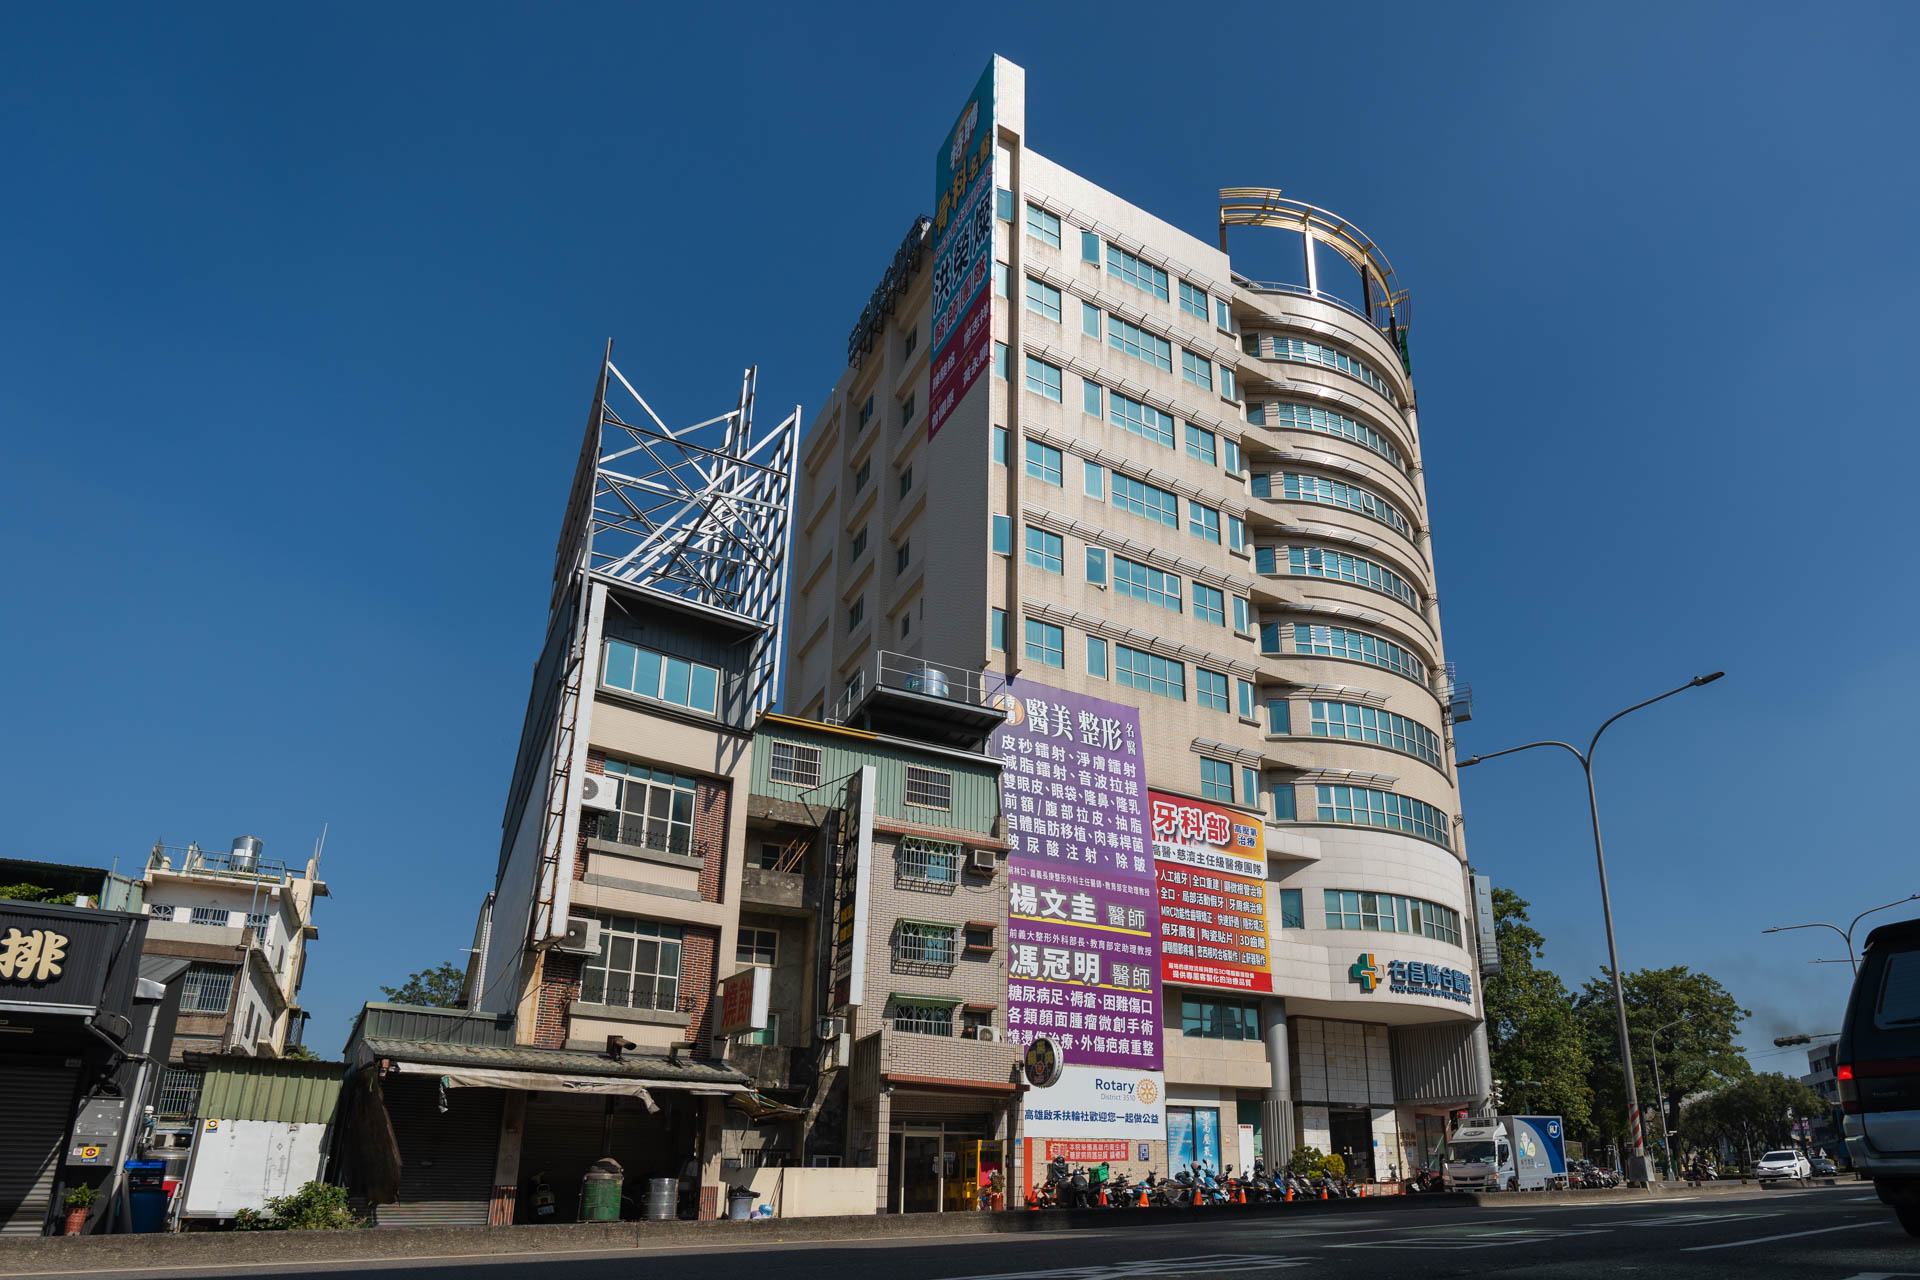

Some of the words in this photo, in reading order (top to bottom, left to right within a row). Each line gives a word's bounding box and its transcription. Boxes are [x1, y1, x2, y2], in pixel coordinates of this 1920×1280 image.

[1003, 772, 1140, 815] 雙眼皮、眼袋、隆鼻、隆乳
[1004, 793, 1142, 834] 前額/腹部拉皮、抽脂
[1007, 813, 1144, 854] 自體脂肪移植、肉毒桿菌
[1153, 802, 1230, 844] 牙科部
[1238, 835, 1257, 848] 治療
[1010, 883, 1097, 923] 楊文圭
[1108, 905, 1145, 929] 醫師
[0, 928, 68, 979] 排
[1010, 944, 1100, 983] 馮冠明
[1112, 964, 1150, 988] 醫師
[1007, 984, 1153, 1015] 糖尿病足、褥瘡、困難傷口
[1095, 1078, 1135, 1094] Rotary
[1100, 1093, 1121, 1101] District
[1123, 1094, 1136, 1102] 3510
